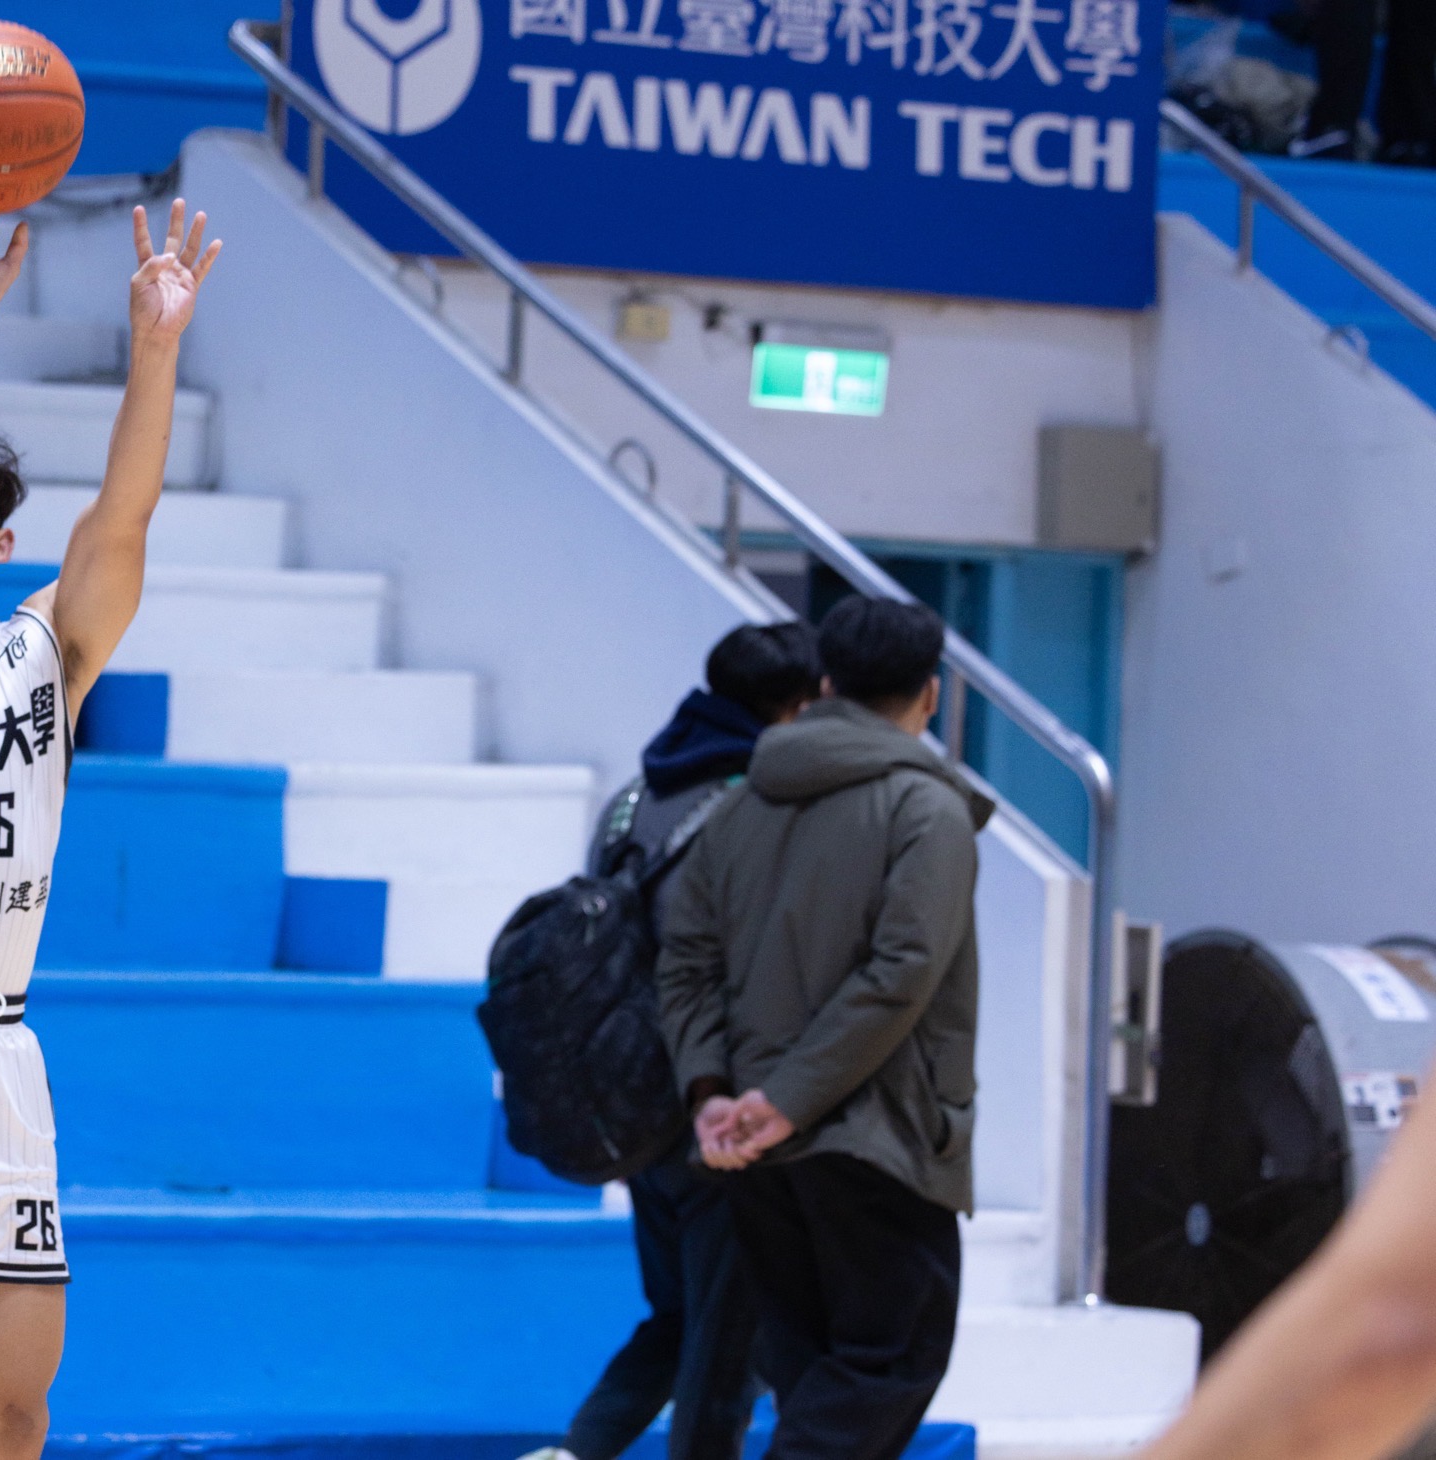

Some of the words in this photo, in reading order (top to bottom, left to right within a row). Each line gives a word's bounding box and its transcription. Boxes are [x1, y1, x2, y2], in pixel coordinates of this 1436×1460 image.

[508, 63, 872, 171] TAIWAN
[896, 100, 1135, 193] TECH
[14, 1199, 58, 1251] 26
